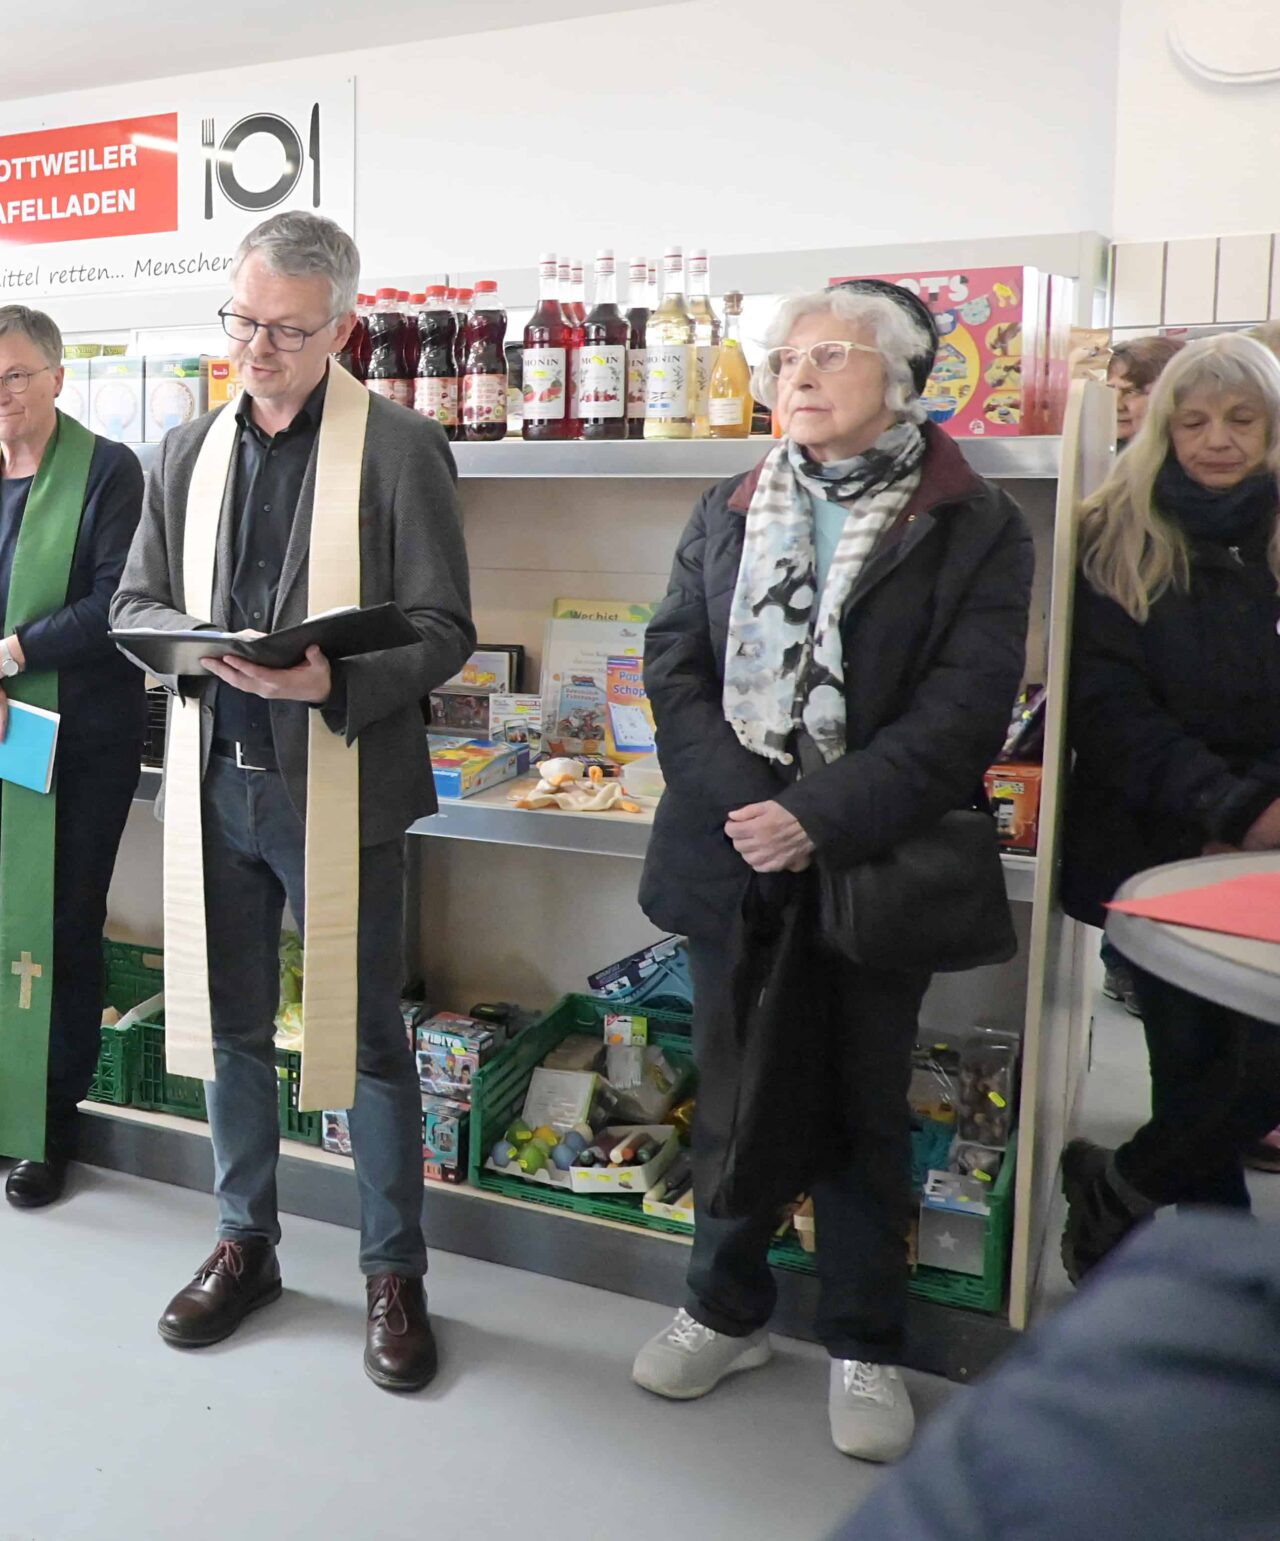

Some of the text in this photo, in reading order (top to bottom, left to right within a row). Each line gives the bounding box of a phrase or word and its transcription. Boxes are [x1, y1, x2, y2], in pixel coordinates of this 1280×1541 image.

[49, 264, 124, 285] retten...
[895, 275, 969, 302] OTS
[581, 356, 619, 365] MOIN
